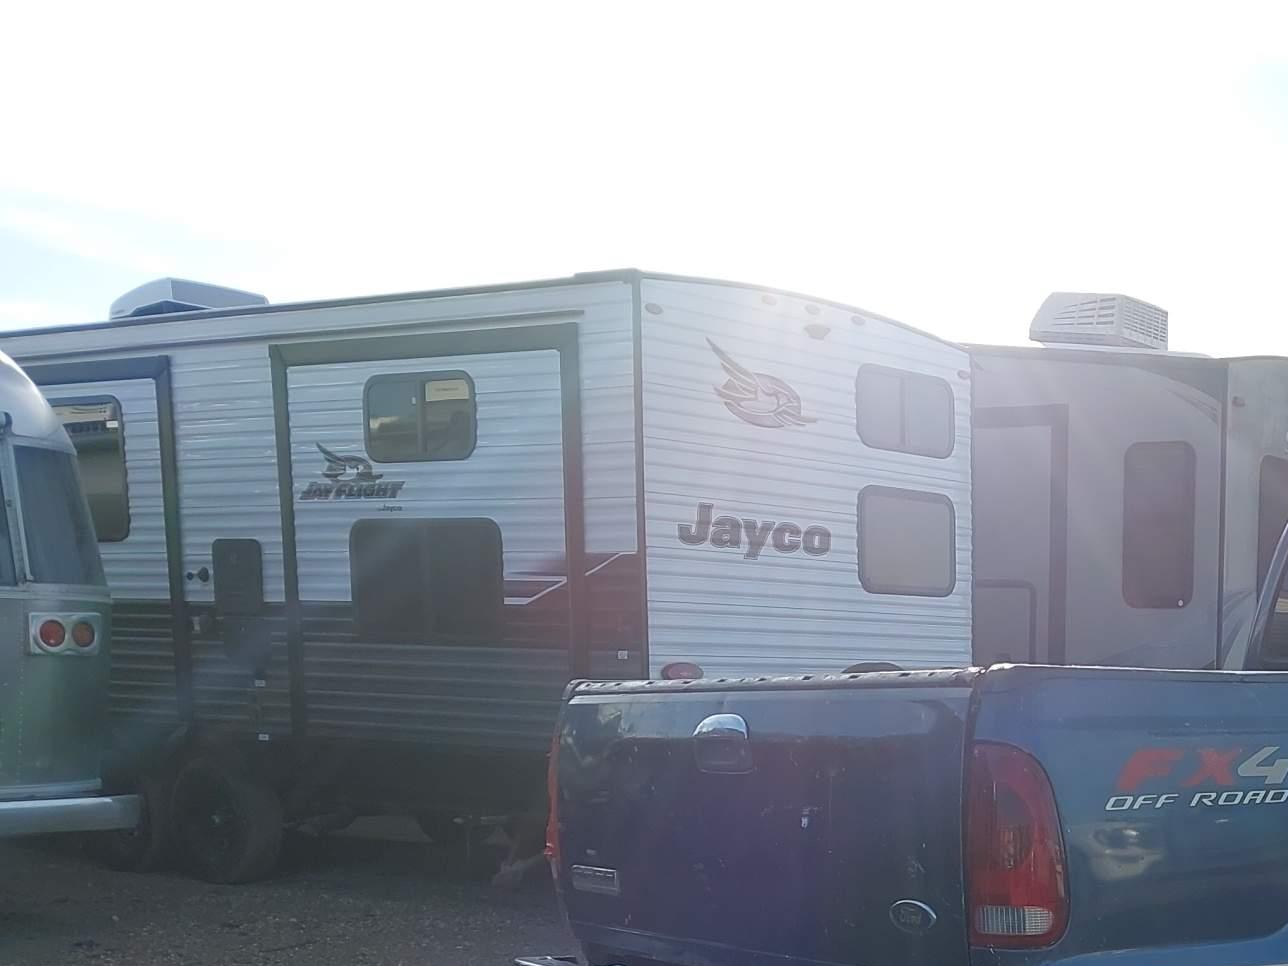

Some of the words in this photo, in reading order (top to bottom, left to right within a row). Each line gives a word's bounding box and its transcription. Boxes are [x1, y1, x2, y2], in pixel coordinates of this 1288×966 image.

[334, 480, 406, 499] FLIGHT
[677, 502, 832, 560] Jayco
[1105, 793, 1179, 811] OFF
